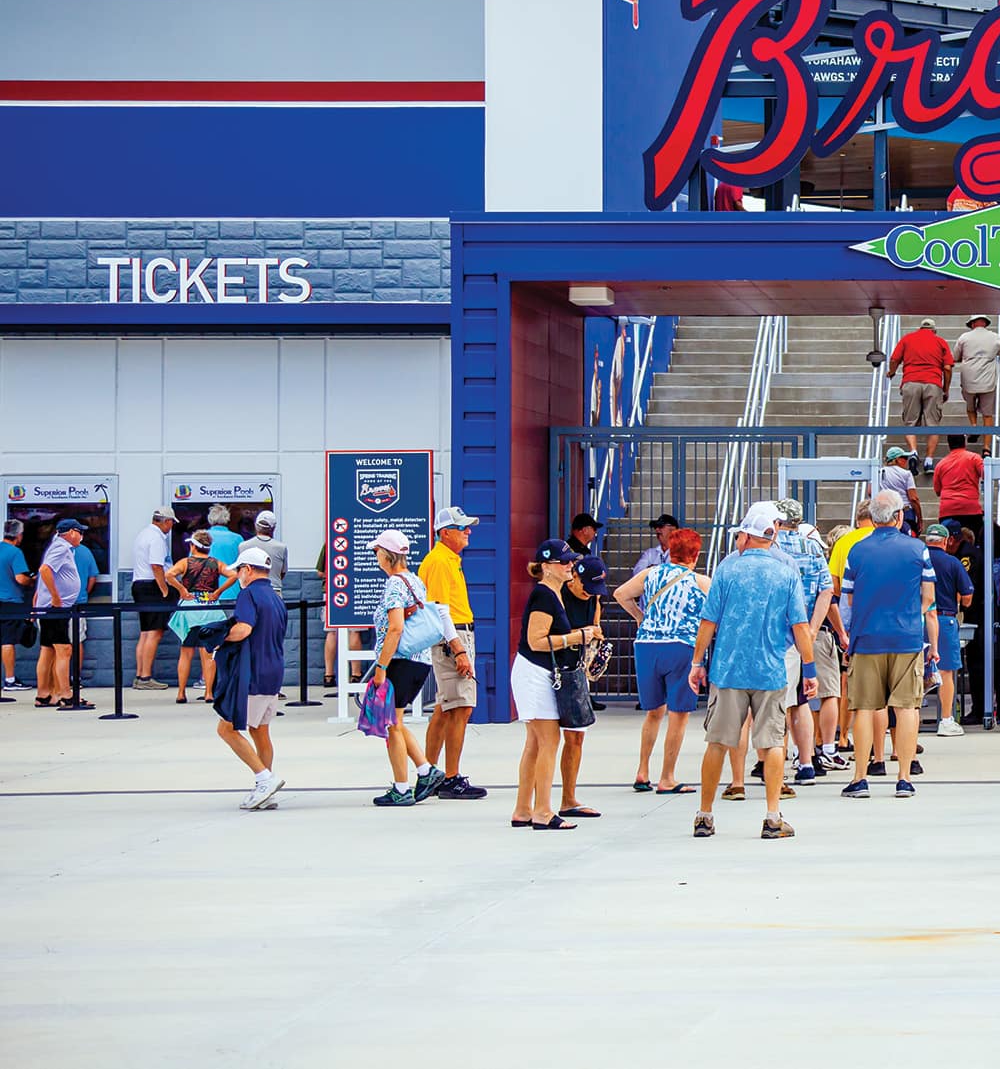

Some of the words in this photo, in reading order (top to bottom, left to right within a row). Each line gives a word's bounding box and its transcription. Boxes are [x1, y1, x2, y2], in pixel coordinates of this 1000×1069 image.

[97, 257, 313, 303] TICKETS
[356, 458, 391, 466] WELCOME
[393, 458, 403, 466] TO
